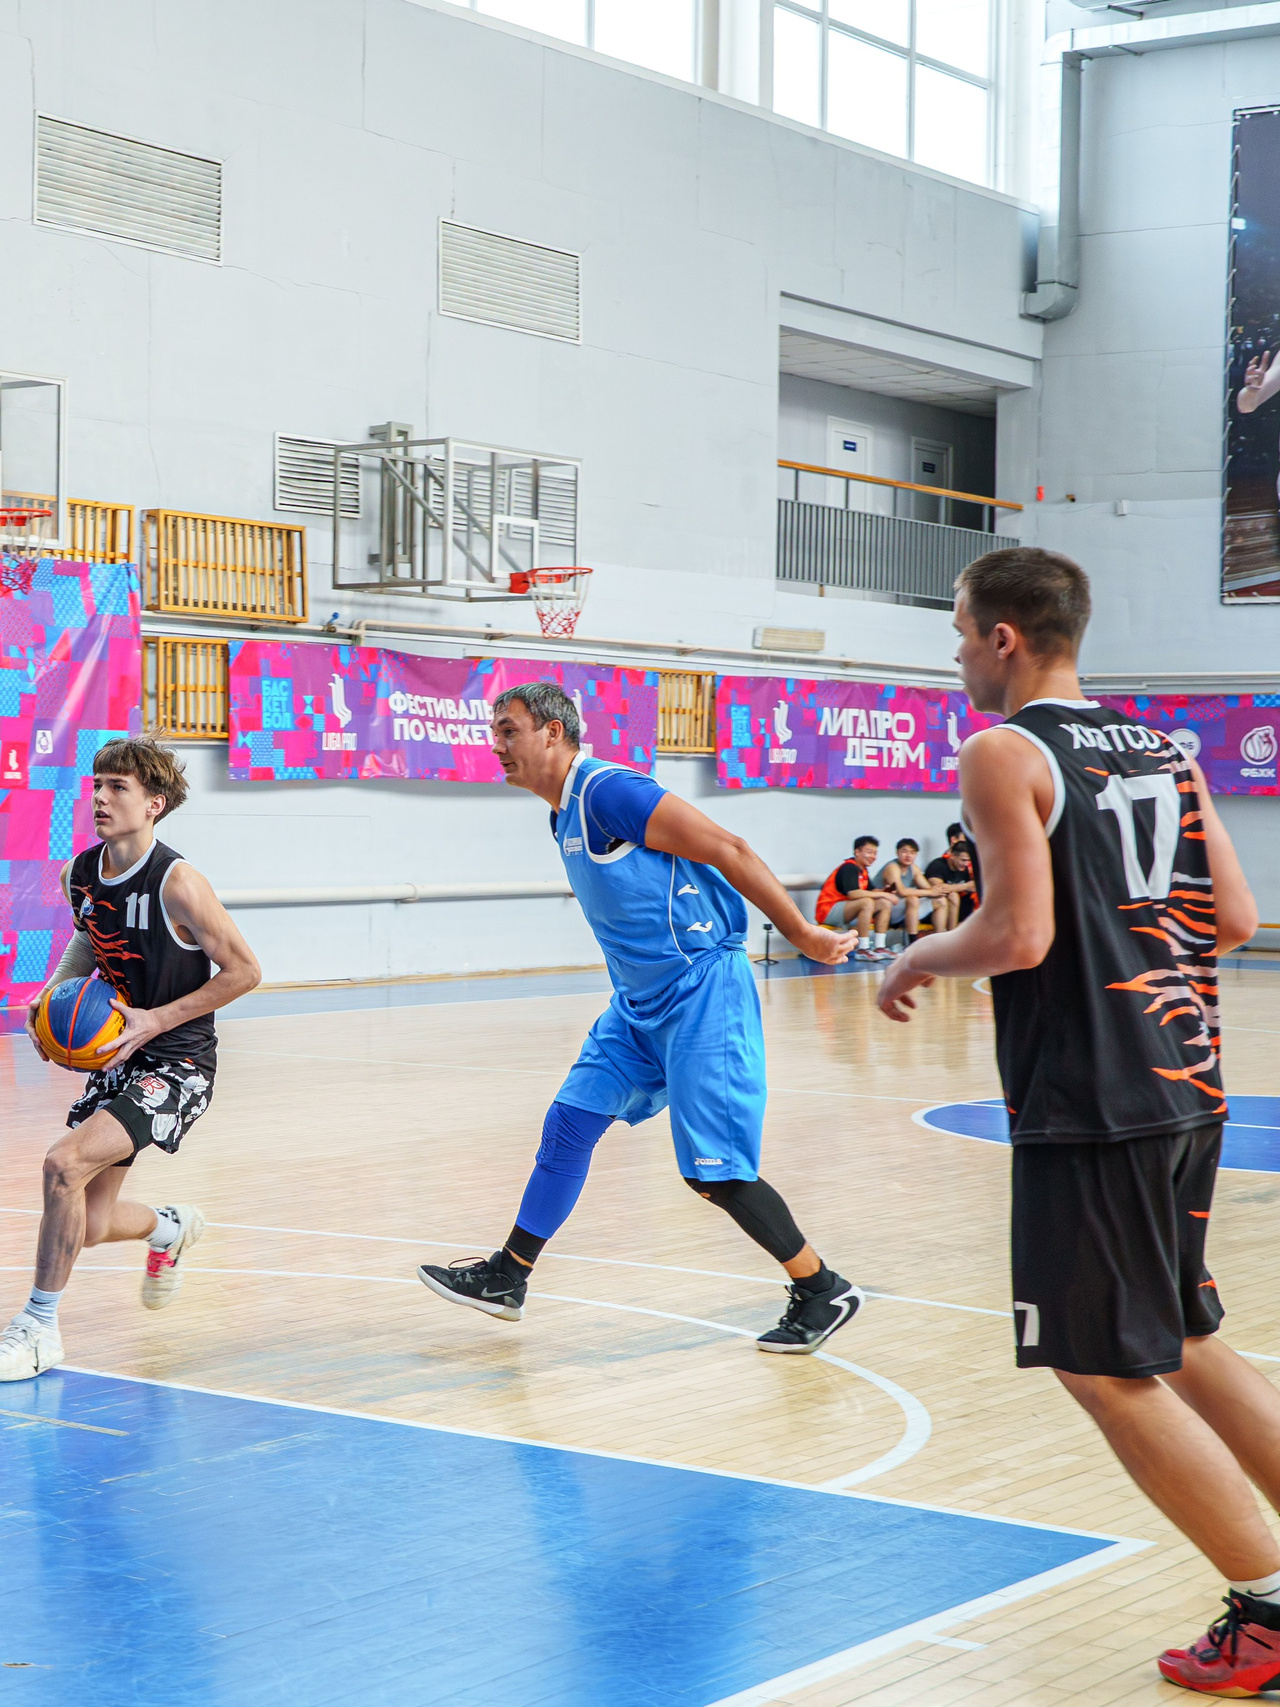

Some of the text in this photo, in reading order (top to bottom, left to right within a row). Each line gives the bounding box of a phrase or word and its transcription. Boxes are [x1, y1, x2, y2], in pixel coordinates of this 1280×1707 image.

[261, 680, 289, 697] БАС
[262, 696, 289, 712] КЕТ
[388, 690, 495, 720] ФЕСТИВАЛЬ
[262, 712, 291, 729] БОЛ
[393, 718, 495, 746] ПО БАСКЕТ
[844, 738, 925, 769] ДЕТЯМ
[1095, 773, 1182, 900] 17
[125, 892, 150, 930] 11
